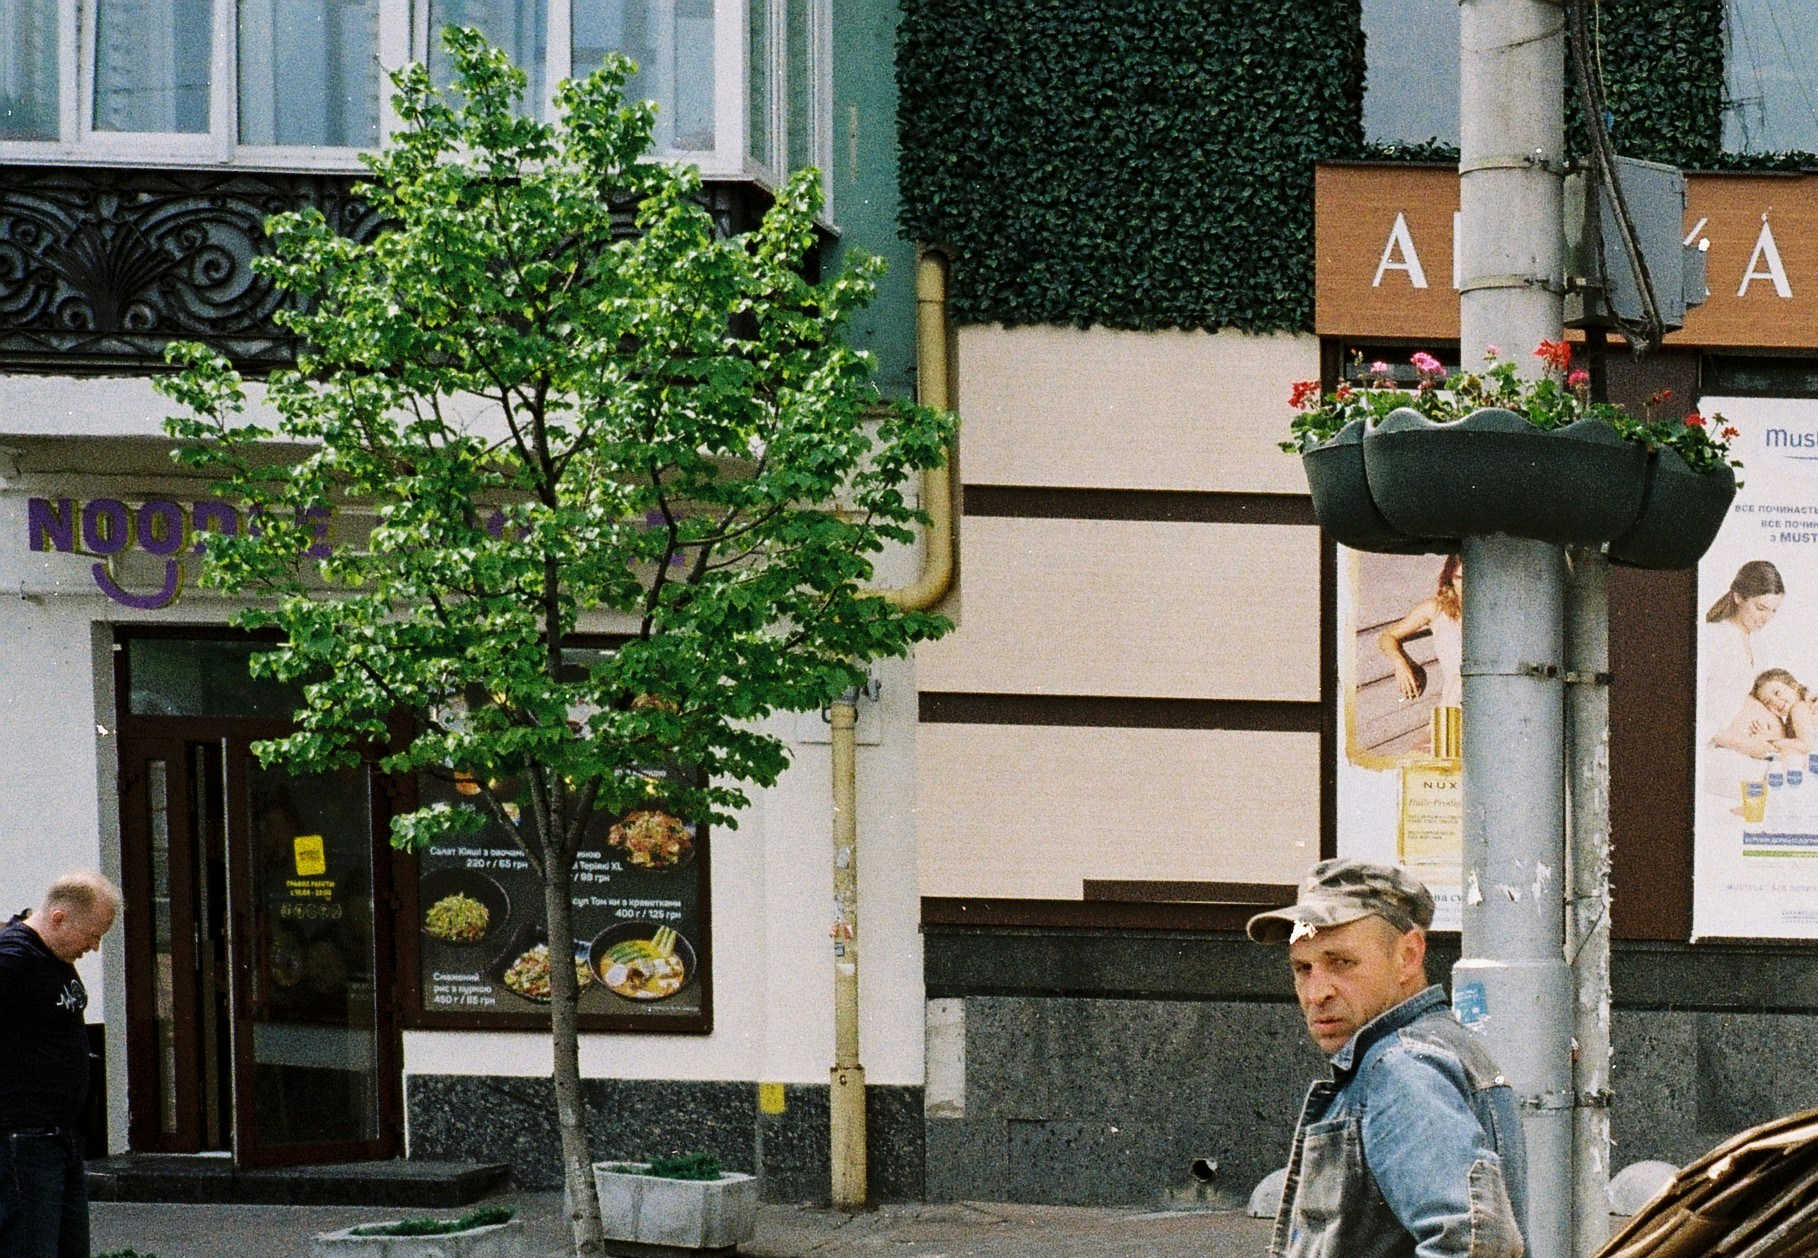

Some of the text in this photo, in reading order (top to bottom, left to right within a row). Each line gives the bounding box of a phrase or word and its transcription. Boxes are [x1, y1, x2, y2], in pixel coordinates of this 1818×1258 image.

[1735, 505, 1755, 513] ВСЕ
[1761, 520, 1781, 528] ВСЕ
[466, 858, 484, 868] 220
[513, 860, 528, 870] грн
[614, 908, 634, 918] 400
[649, 909, 665, 919] 125
